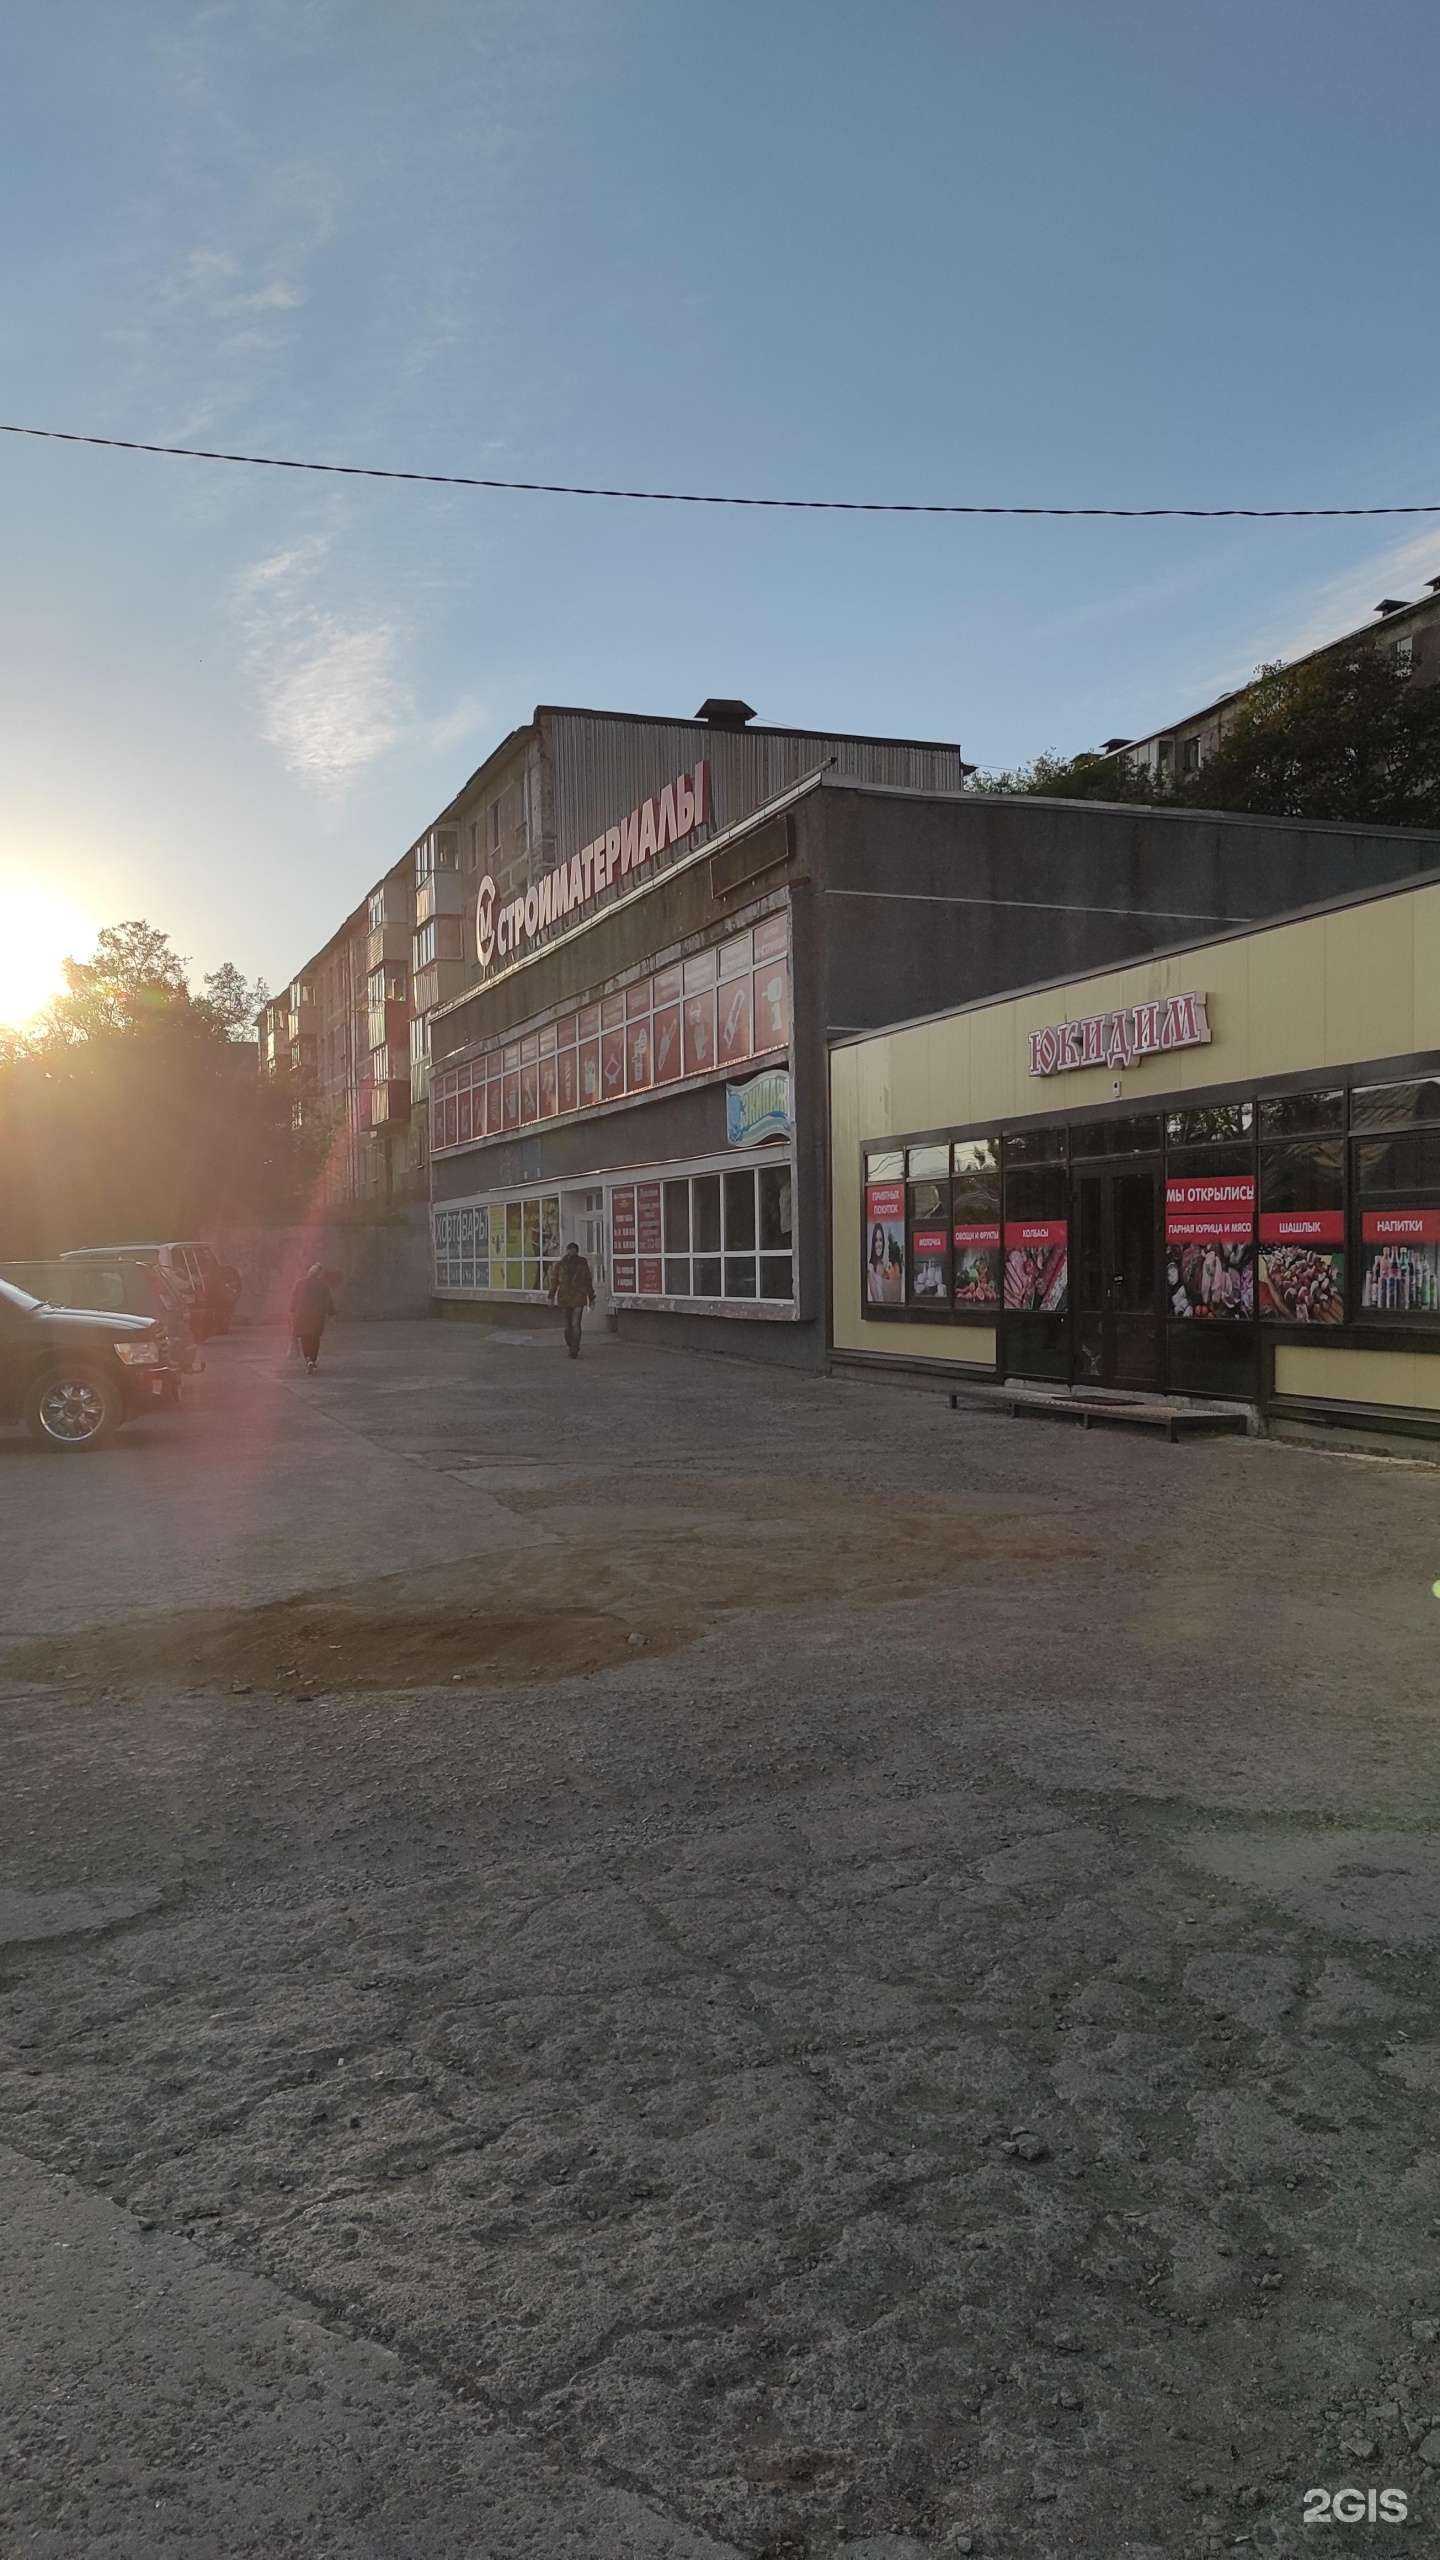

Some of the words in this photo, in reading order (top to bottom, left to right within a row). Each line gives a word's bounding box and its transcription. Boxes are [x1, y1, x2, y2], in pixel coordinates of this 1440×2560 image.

[1028, 991, 1206, 1075] ЮКИДИМ
[1167, 1188, 1184, 1202] МЫ
[1187, 1185, 1254, 1201] ОТКРЫЛИСЬ
[1168, 1224, 1195, 1234] ПАРНАЯ
[1195, 1223, 1223, 1235] КУРИЦА
[1224, 1223, 1230, 1233] И
[1231, 1222, 1252, 1233] МЯСО
[1279, 1220, 1321, 1234] ШАШЛЫК
[1376, 1220, 1423, 1232] НАПИТКИ
[1022, 1228, 1049, 1238] КОЛБАСЫ
